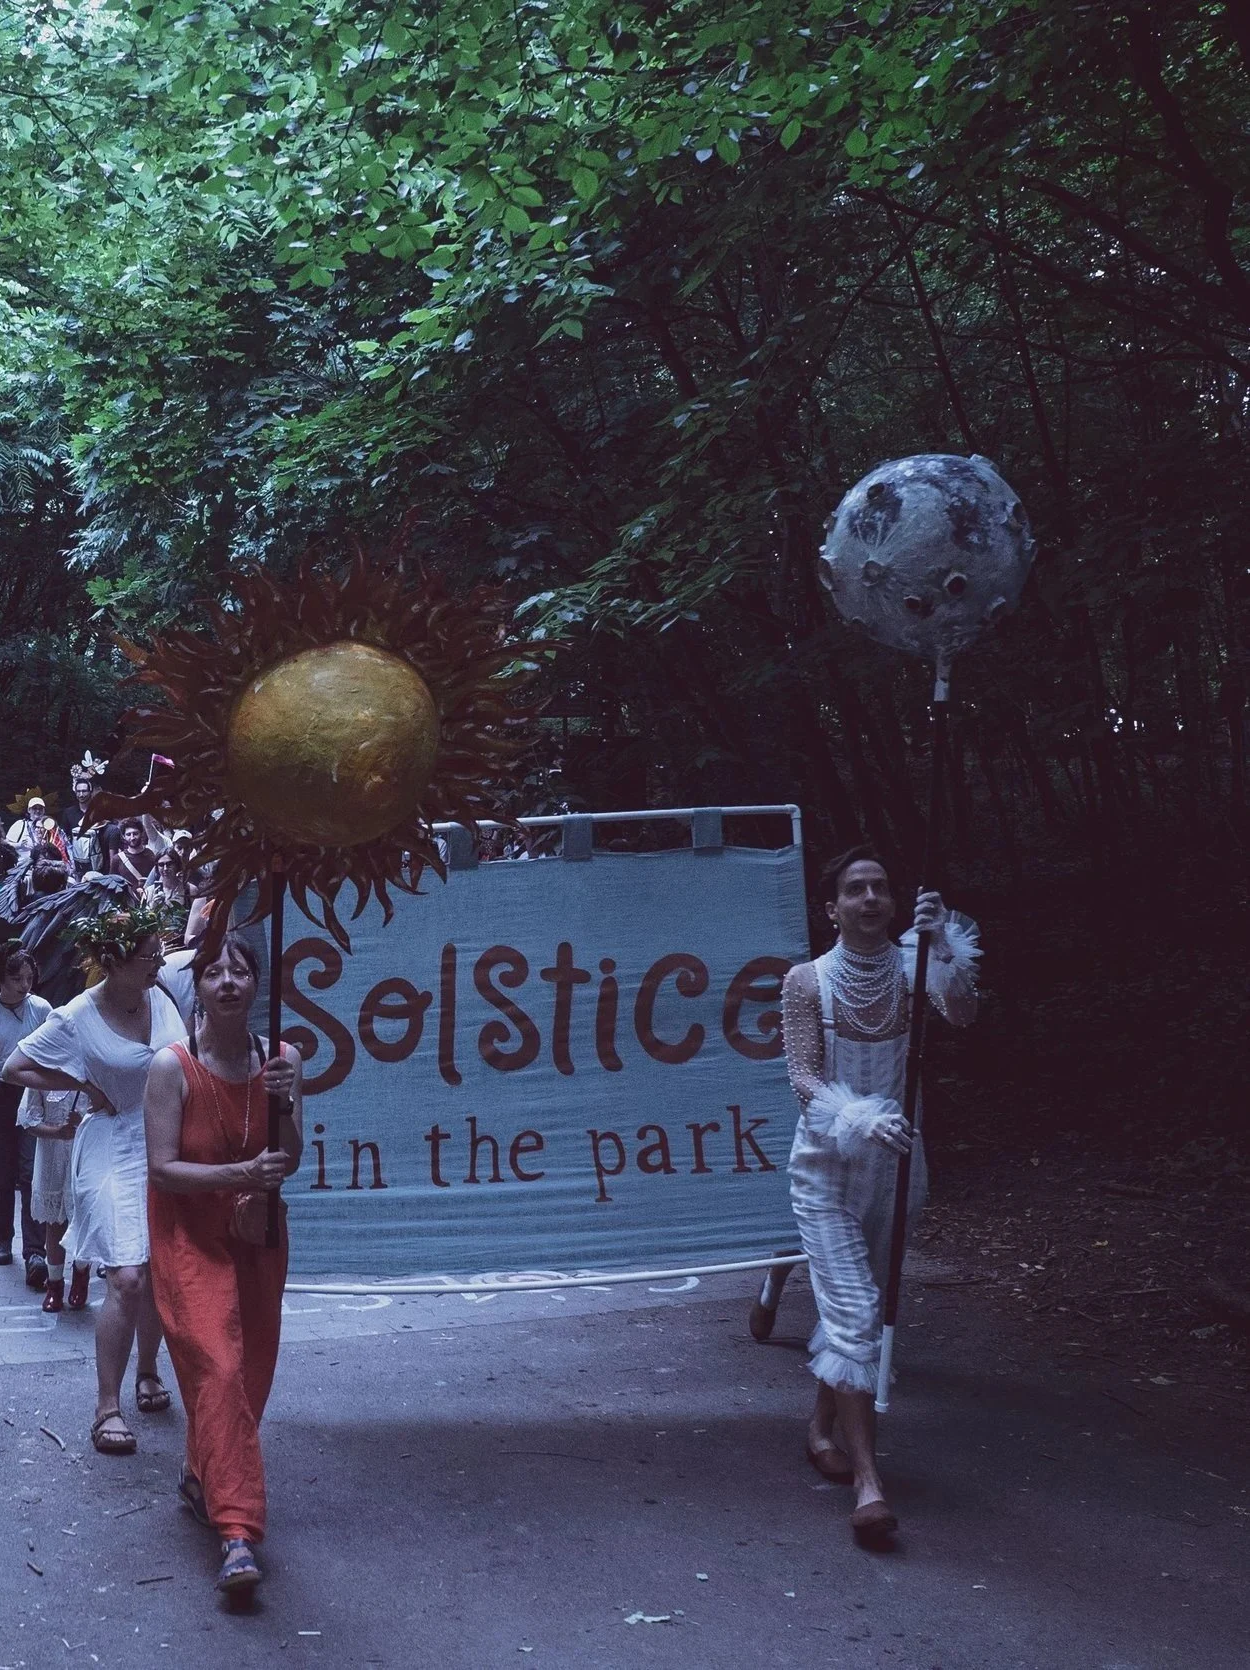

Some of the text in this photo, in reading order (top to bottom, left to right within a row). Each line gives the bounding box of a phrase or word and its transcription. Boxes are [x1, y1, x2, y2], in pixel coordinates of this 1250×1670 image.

[281, 937, 785, 1095] Solstice
[310, 1105, 777, 1202] in the park
